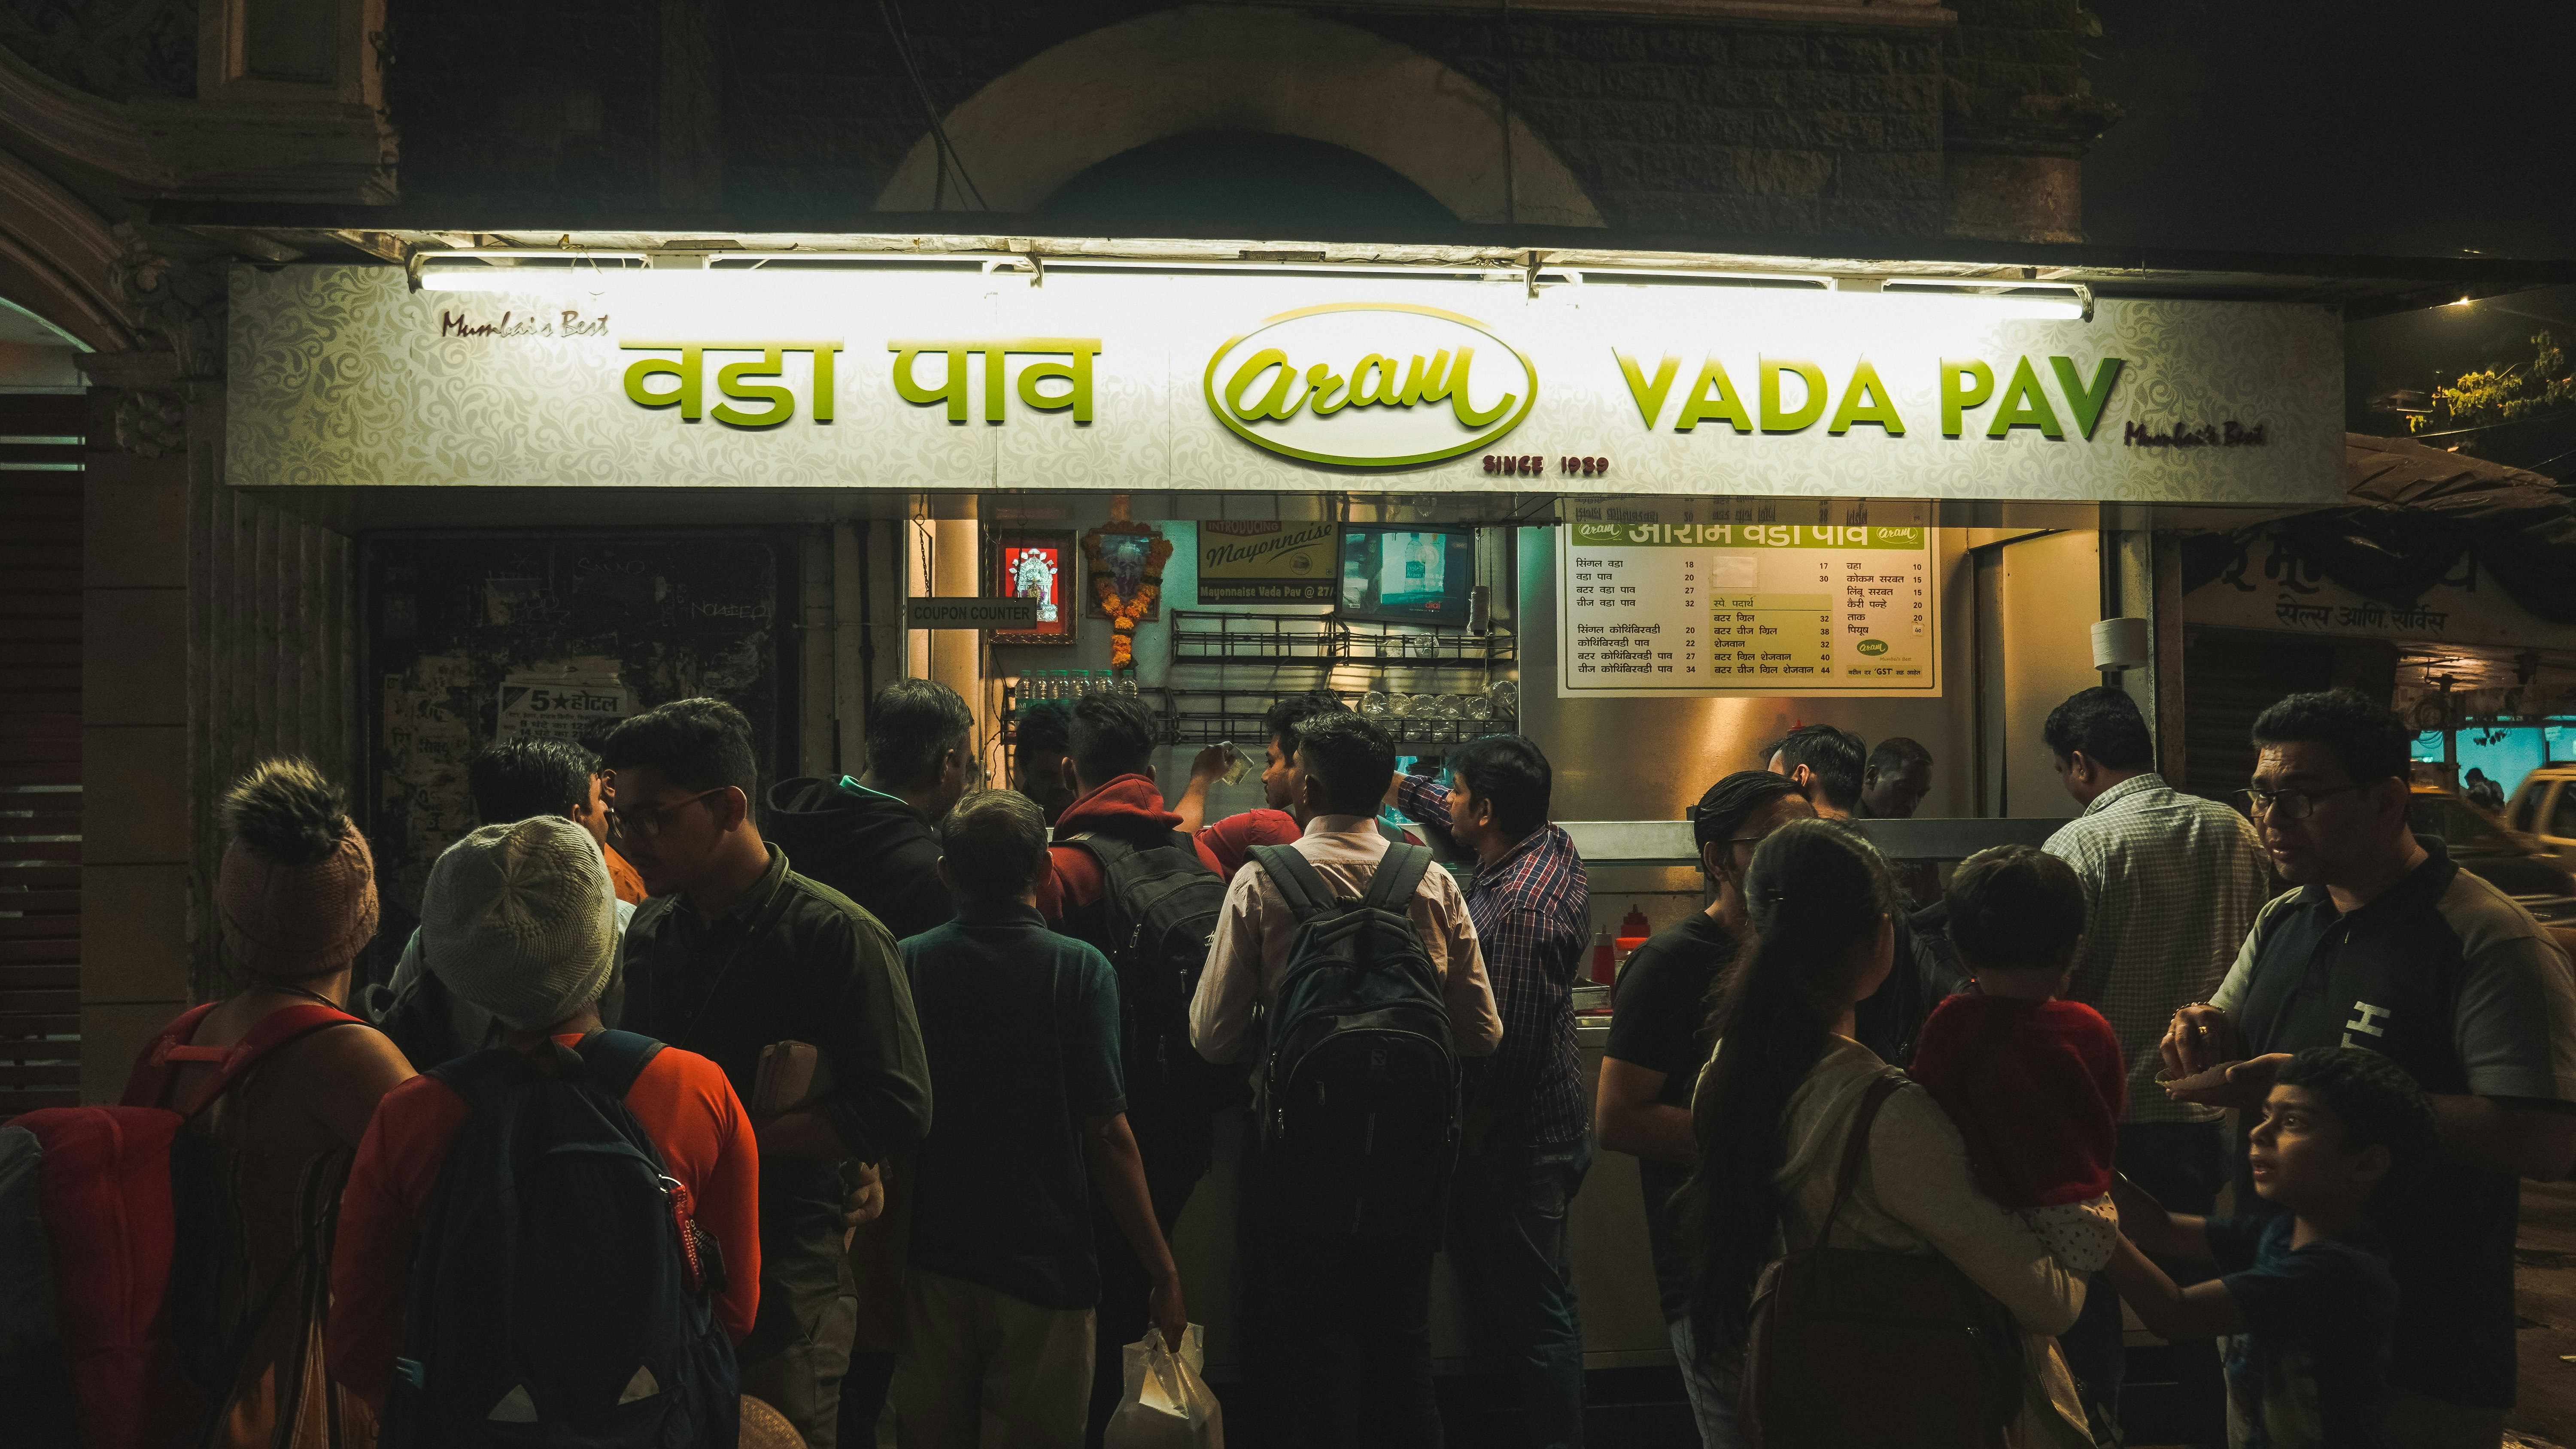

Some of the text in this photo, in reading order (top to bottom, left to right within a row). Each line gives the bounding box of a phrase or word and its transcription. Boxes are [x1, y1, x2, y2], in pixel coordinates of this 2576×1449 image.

[561, 310, 608, 337] Best
[619, 337, 1102, 431] वडा पाव
[1611, 346, 2122, 442] VADA PAV
[1483, 455, 1610, 474] SINCE 1939
[1208, 521, 1279, 534] INTRODUCING
[1744, 525, 1800, 546] वडा
[1812, 525, 1868, 546] पाव
[1206, 522, 1331, 567] Mayonnaise
[1576, 557, 1603, 567] सिंगल
[1846, 573, 1874, 582] कोकम
[1200, 586, 1256, 600] Mayonnaise
[1258, 586, 1281, 597] Vada
[1284, 587, 1301, 597] Pav
[1847, 585, 1865, 597] लिंबू
[1576, 596, 1595, 606] चीज
[1732, 597, 1754, 608] पदार्थ
[1847, 597, 1864, 608] कैरी
[1869, 598, 1887, 609] पन्हे
[914, 606, 1030, 620] COUPON COUNTER
[1736, 612, 1755, 622] ग्रिल
[1577, 624, 1604, 634] सिंगल
[1609, 623, 1661, 634] कोथिंबिरवडी
[1736, 624, 1754, 635] चीज
[1759, 625, 1777, 635] ग्रिल
[1847, 624, 1869, 636] पियूष
[1577, 636, 1629, 647] कोथिंबिरवडी
[1714, 637, 1746, 648] शेजवान
[1601, 649, 1653, 660] कोथिंबिरवडी
[1737, 651, 1756, 661] ग्रिल
[1760, 651, 1792, 661] शेजवान
[1577, 662, 1596, 673] चीज
[1601, 662, 1653, 673] कोथिंबिरवडी
[1737, 663, 1755, 674] चीज
[1759, 664, 1778, 674] ग्रिल
[1783, 664, 1814, 674] शेजवान
